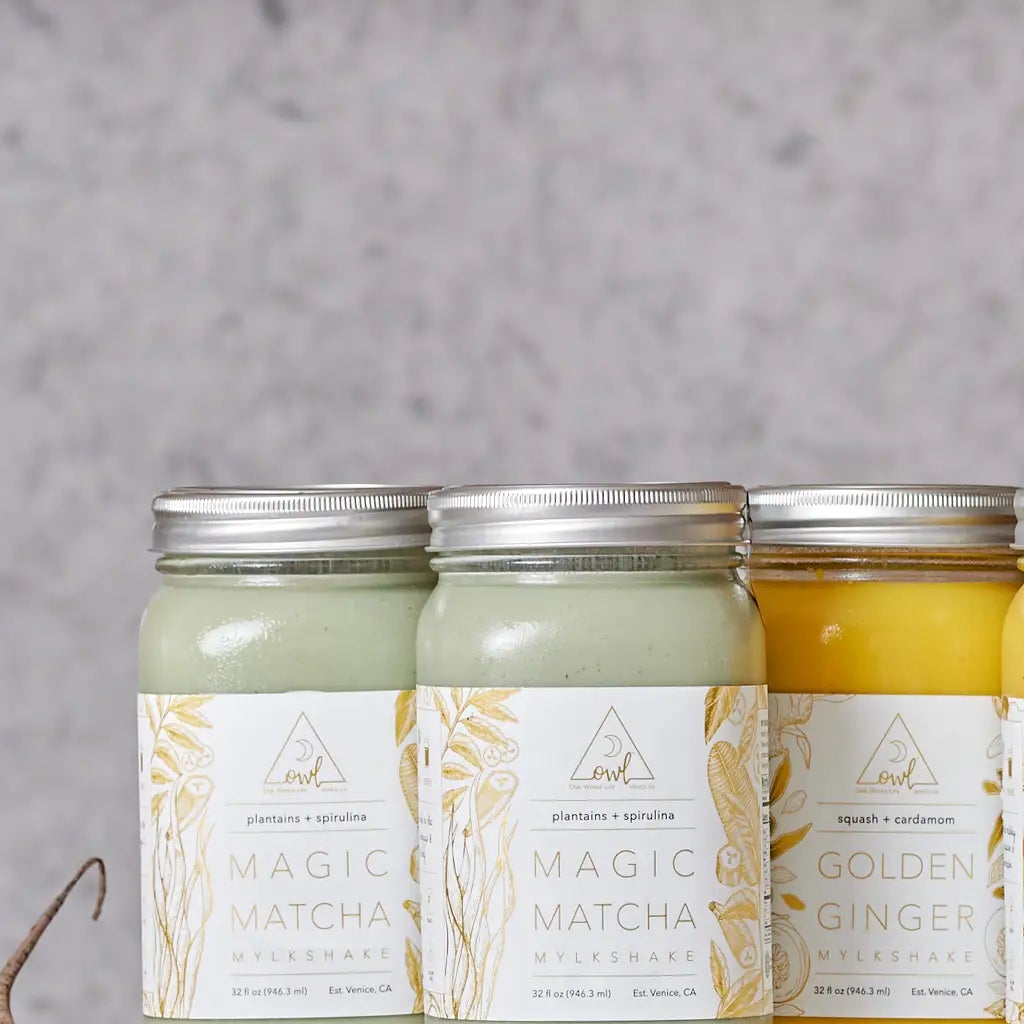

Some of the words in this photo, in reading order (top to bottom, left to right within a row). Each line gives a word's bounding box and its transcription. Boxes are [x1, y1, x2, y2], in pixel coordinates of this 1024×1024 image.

[283, 755, 322, 788] owl
[592, 751, 632, 785] owl
[877, 758, 916, 789] owl
[247, 814, 300, 826] plantains
[317, 812, 367, 823] spirulina
[552, 811, 607, 823] plantains
[624, 810, 675, 822] spirulina
[838, 814, 878, 825] squash
[895, 814, 954, 825] cardamom
[230, 849, 388, 880] MAGIC
[534, 849, 695, 878] MAGIC
[818, 851, 973, 879] GOLDEN
[232, 901, 390, 931] MATCHA
[535, 902, 696, 931] MATCHA
[818, 902, 974, 931] GINGER
[232, 948, 391, 963] MYLKSHAKE
[534, 951, 694, 963] MYLKSHAKE
[818, 949, 973, 962] MYLKSHAKE
[532, 990, 543, 998] 32
[546, 989, 551, 998] fl
[566, 990, 594, 999] (946.3
[597, 989, 611, 998] ml)
[633, 989, 648, 998] Est.
[650, 989, 681, 997] Venice,
[684, 988, 696, 996] CA
